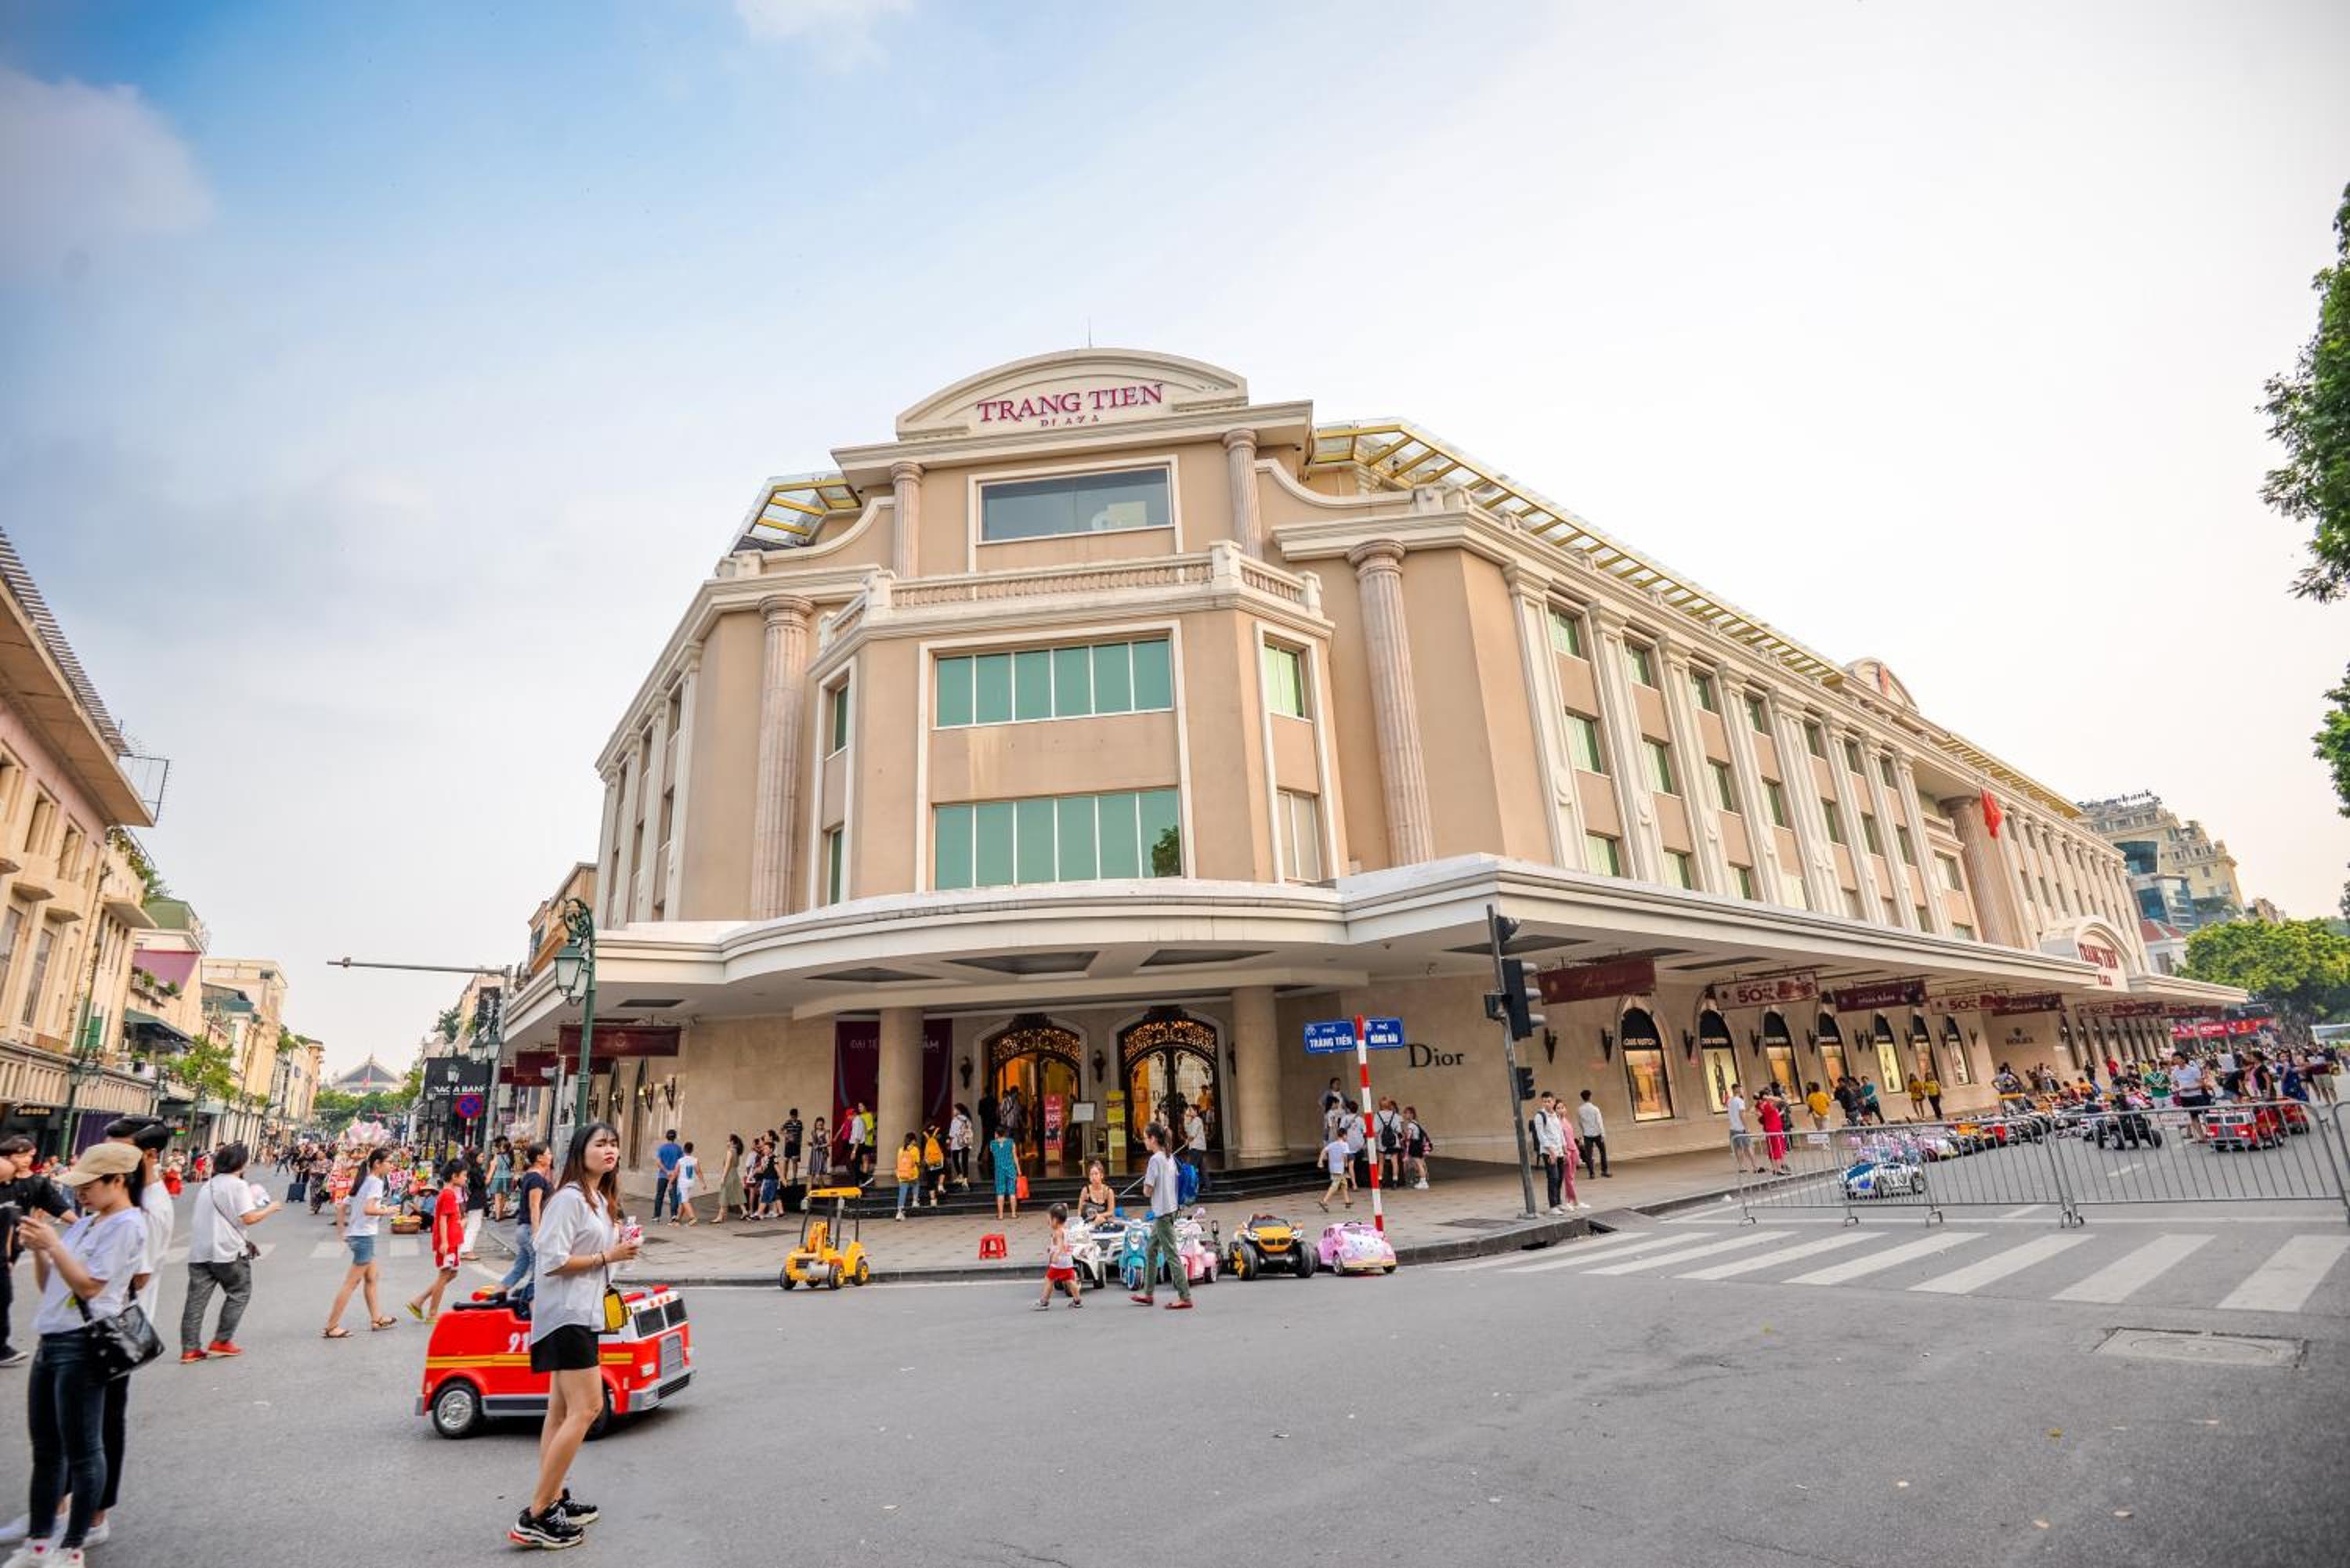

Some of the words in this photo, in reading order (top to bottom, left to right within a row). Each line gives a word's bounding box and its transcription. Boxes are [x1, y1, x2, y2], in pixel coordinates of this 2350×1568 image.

[978, 392, 1081, 422] TRANG
[1088, 383, 1164, 410] TIEN
[1408, 1044, 1464, 1068] Dior
